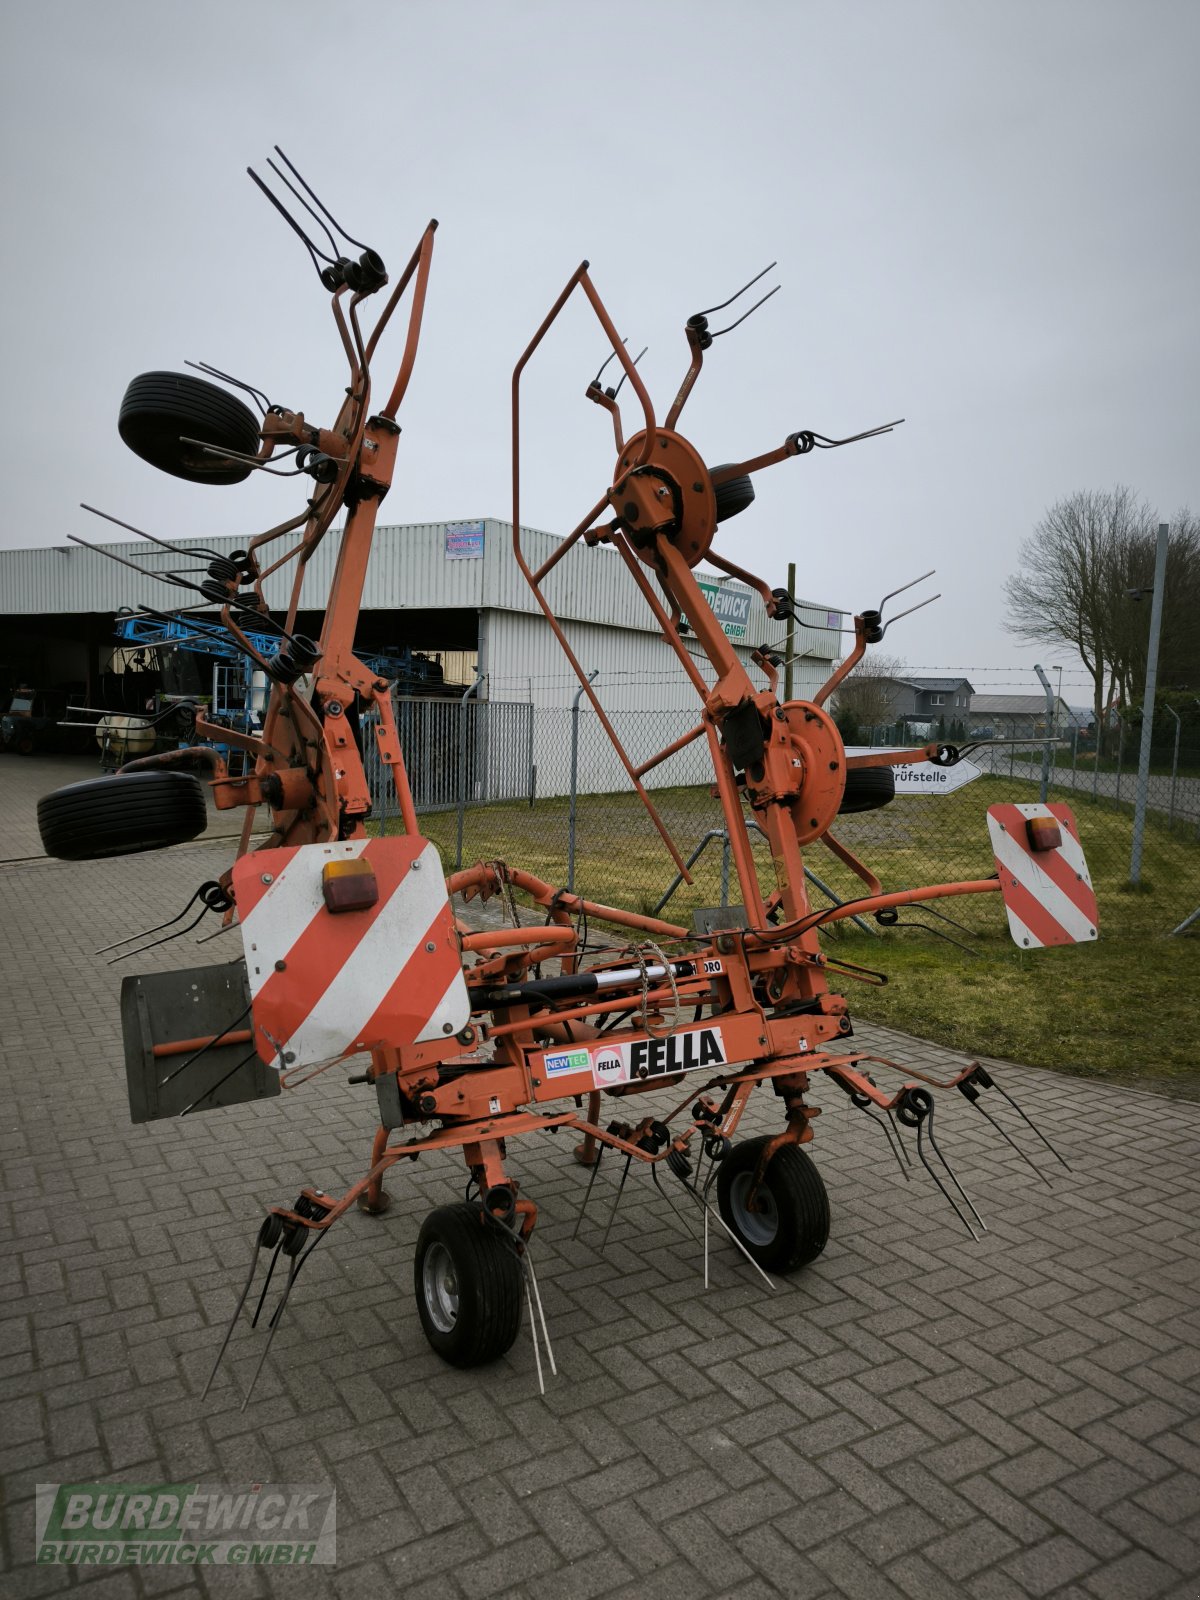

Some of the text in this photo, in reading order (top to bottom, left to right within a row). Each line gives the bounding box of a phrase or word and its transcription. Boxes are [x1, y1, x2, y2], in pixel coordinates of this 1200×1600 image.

[701, 589, 749, 618] DEWICK
[724, 623, 746, 637] GMBH
[895, 771, 947, 782] rüfstelle
[630, 1029, 724, 1079] FELLA
[547, 1054, 587, 1070] NEWTEC
[598, 1060, 621, 1071] FELLA
